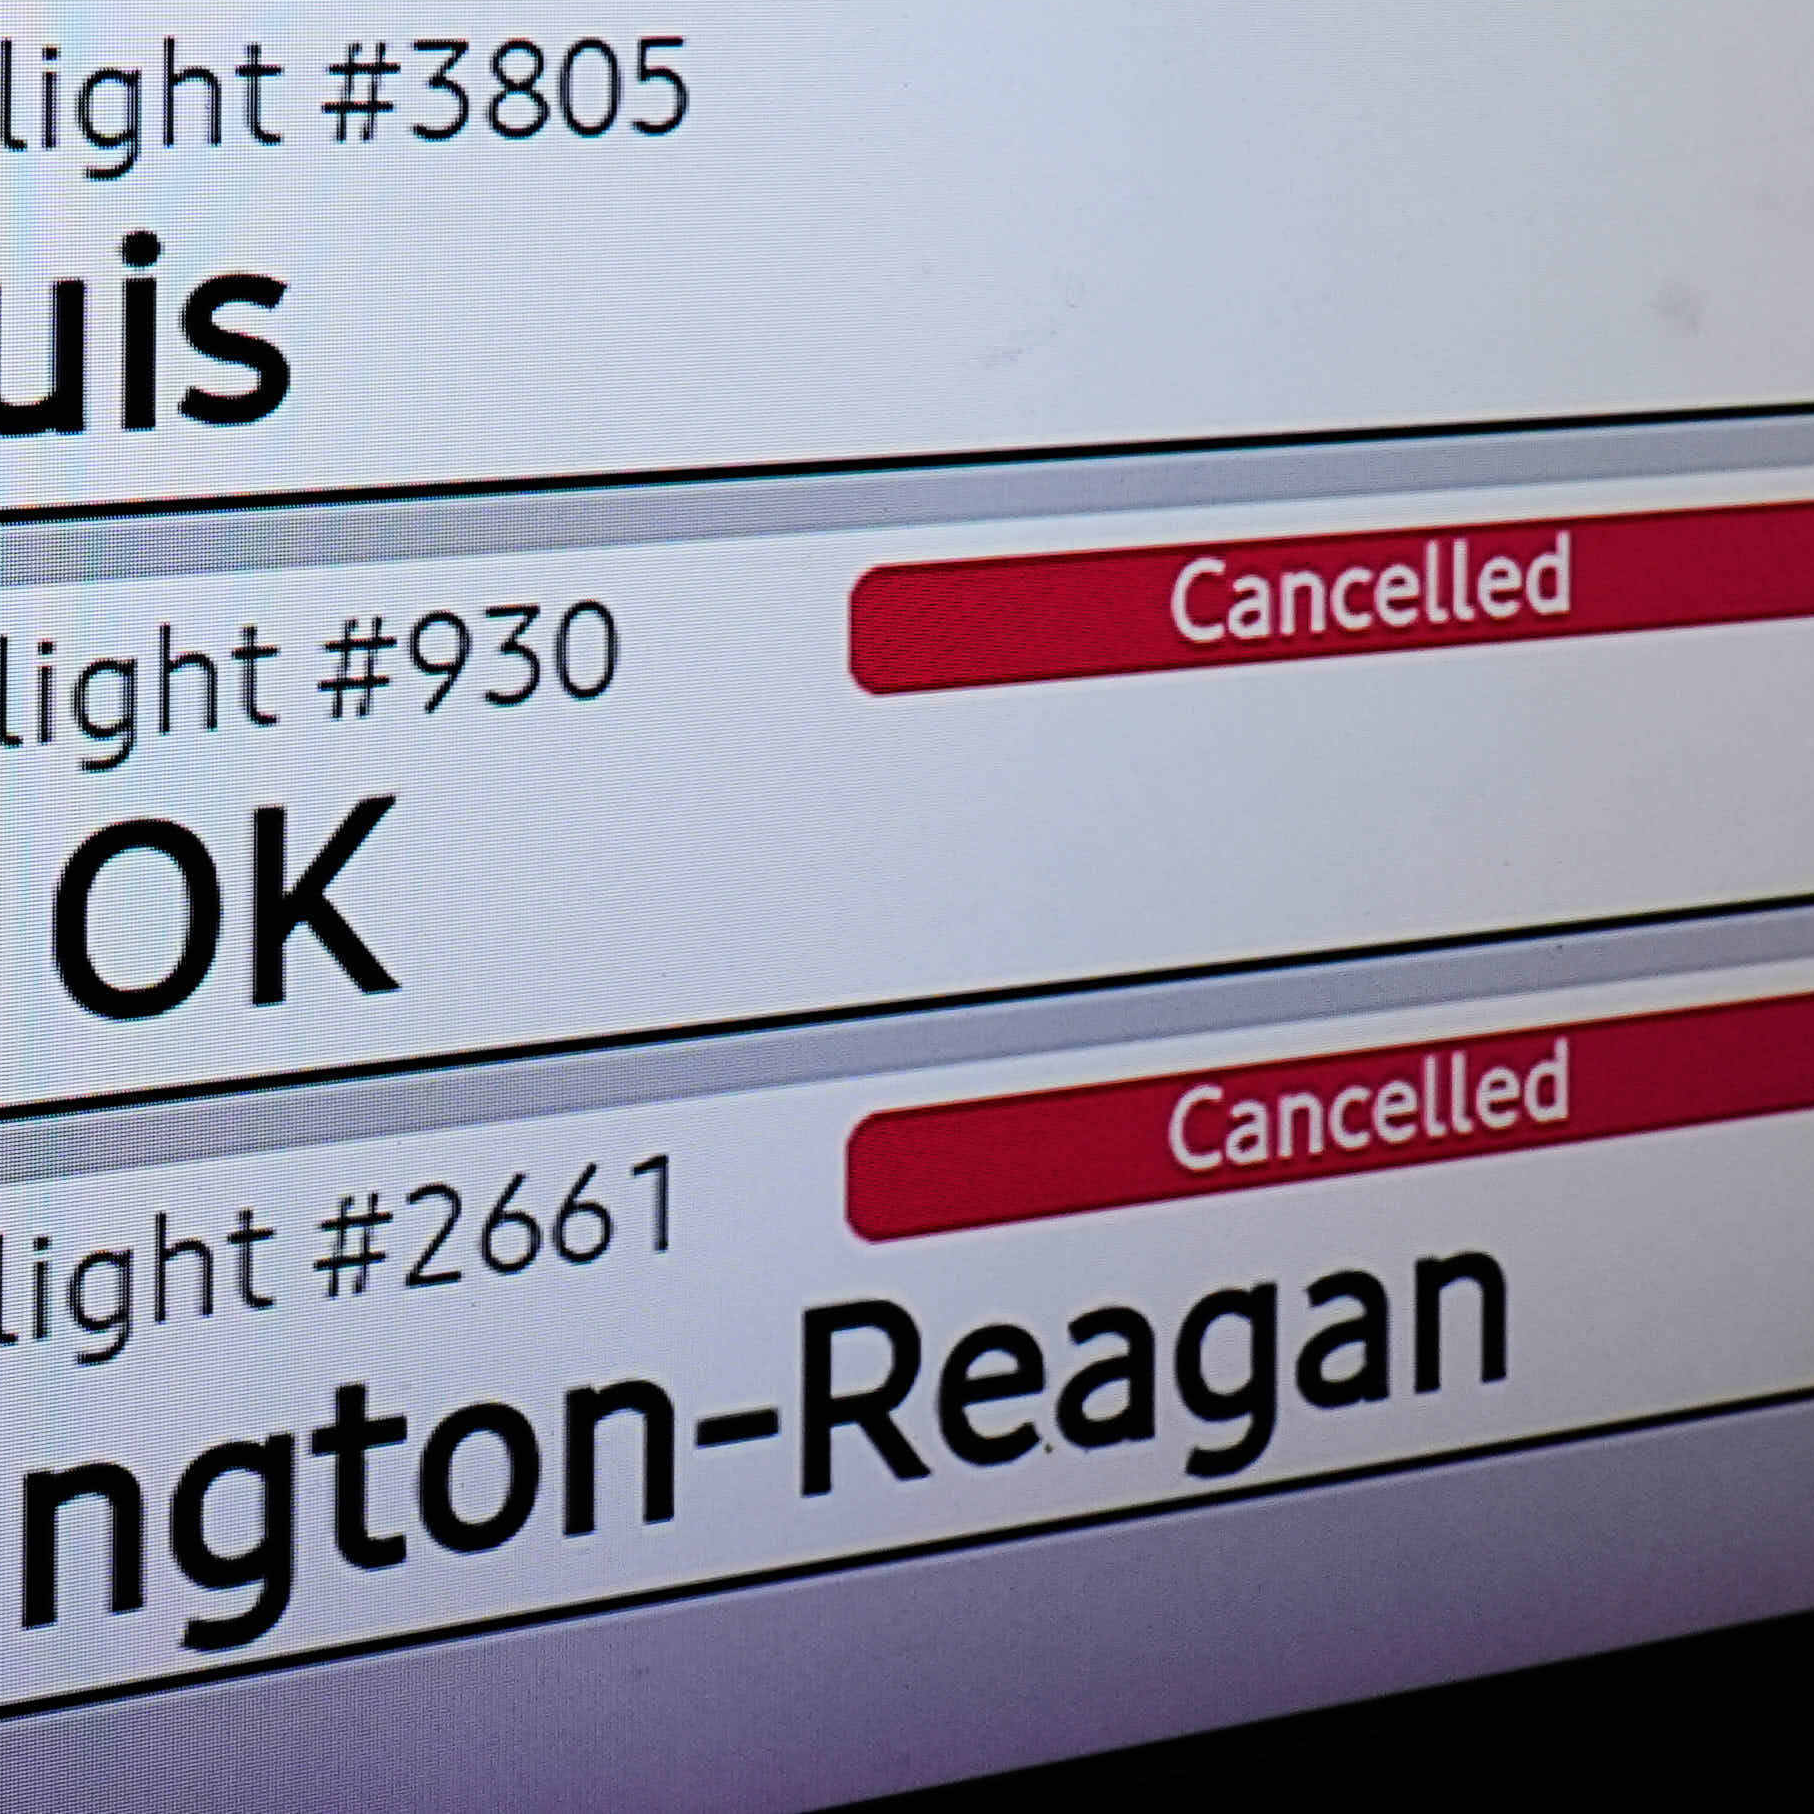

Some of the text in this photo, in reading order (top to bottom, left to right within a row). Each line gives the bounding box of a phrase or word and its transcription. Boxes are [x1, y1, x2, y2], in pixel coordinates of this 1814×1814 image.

[322, 36, 689, 142] #3805
[1170, 530, 1570, 644] Cancelled
[318, 600, 619, 719] #930
[52, 795, 400, 1021] OK
[1167, 1036, 1569, 1173] Cancelled
[314, 1154, 669, 1298] #2661
